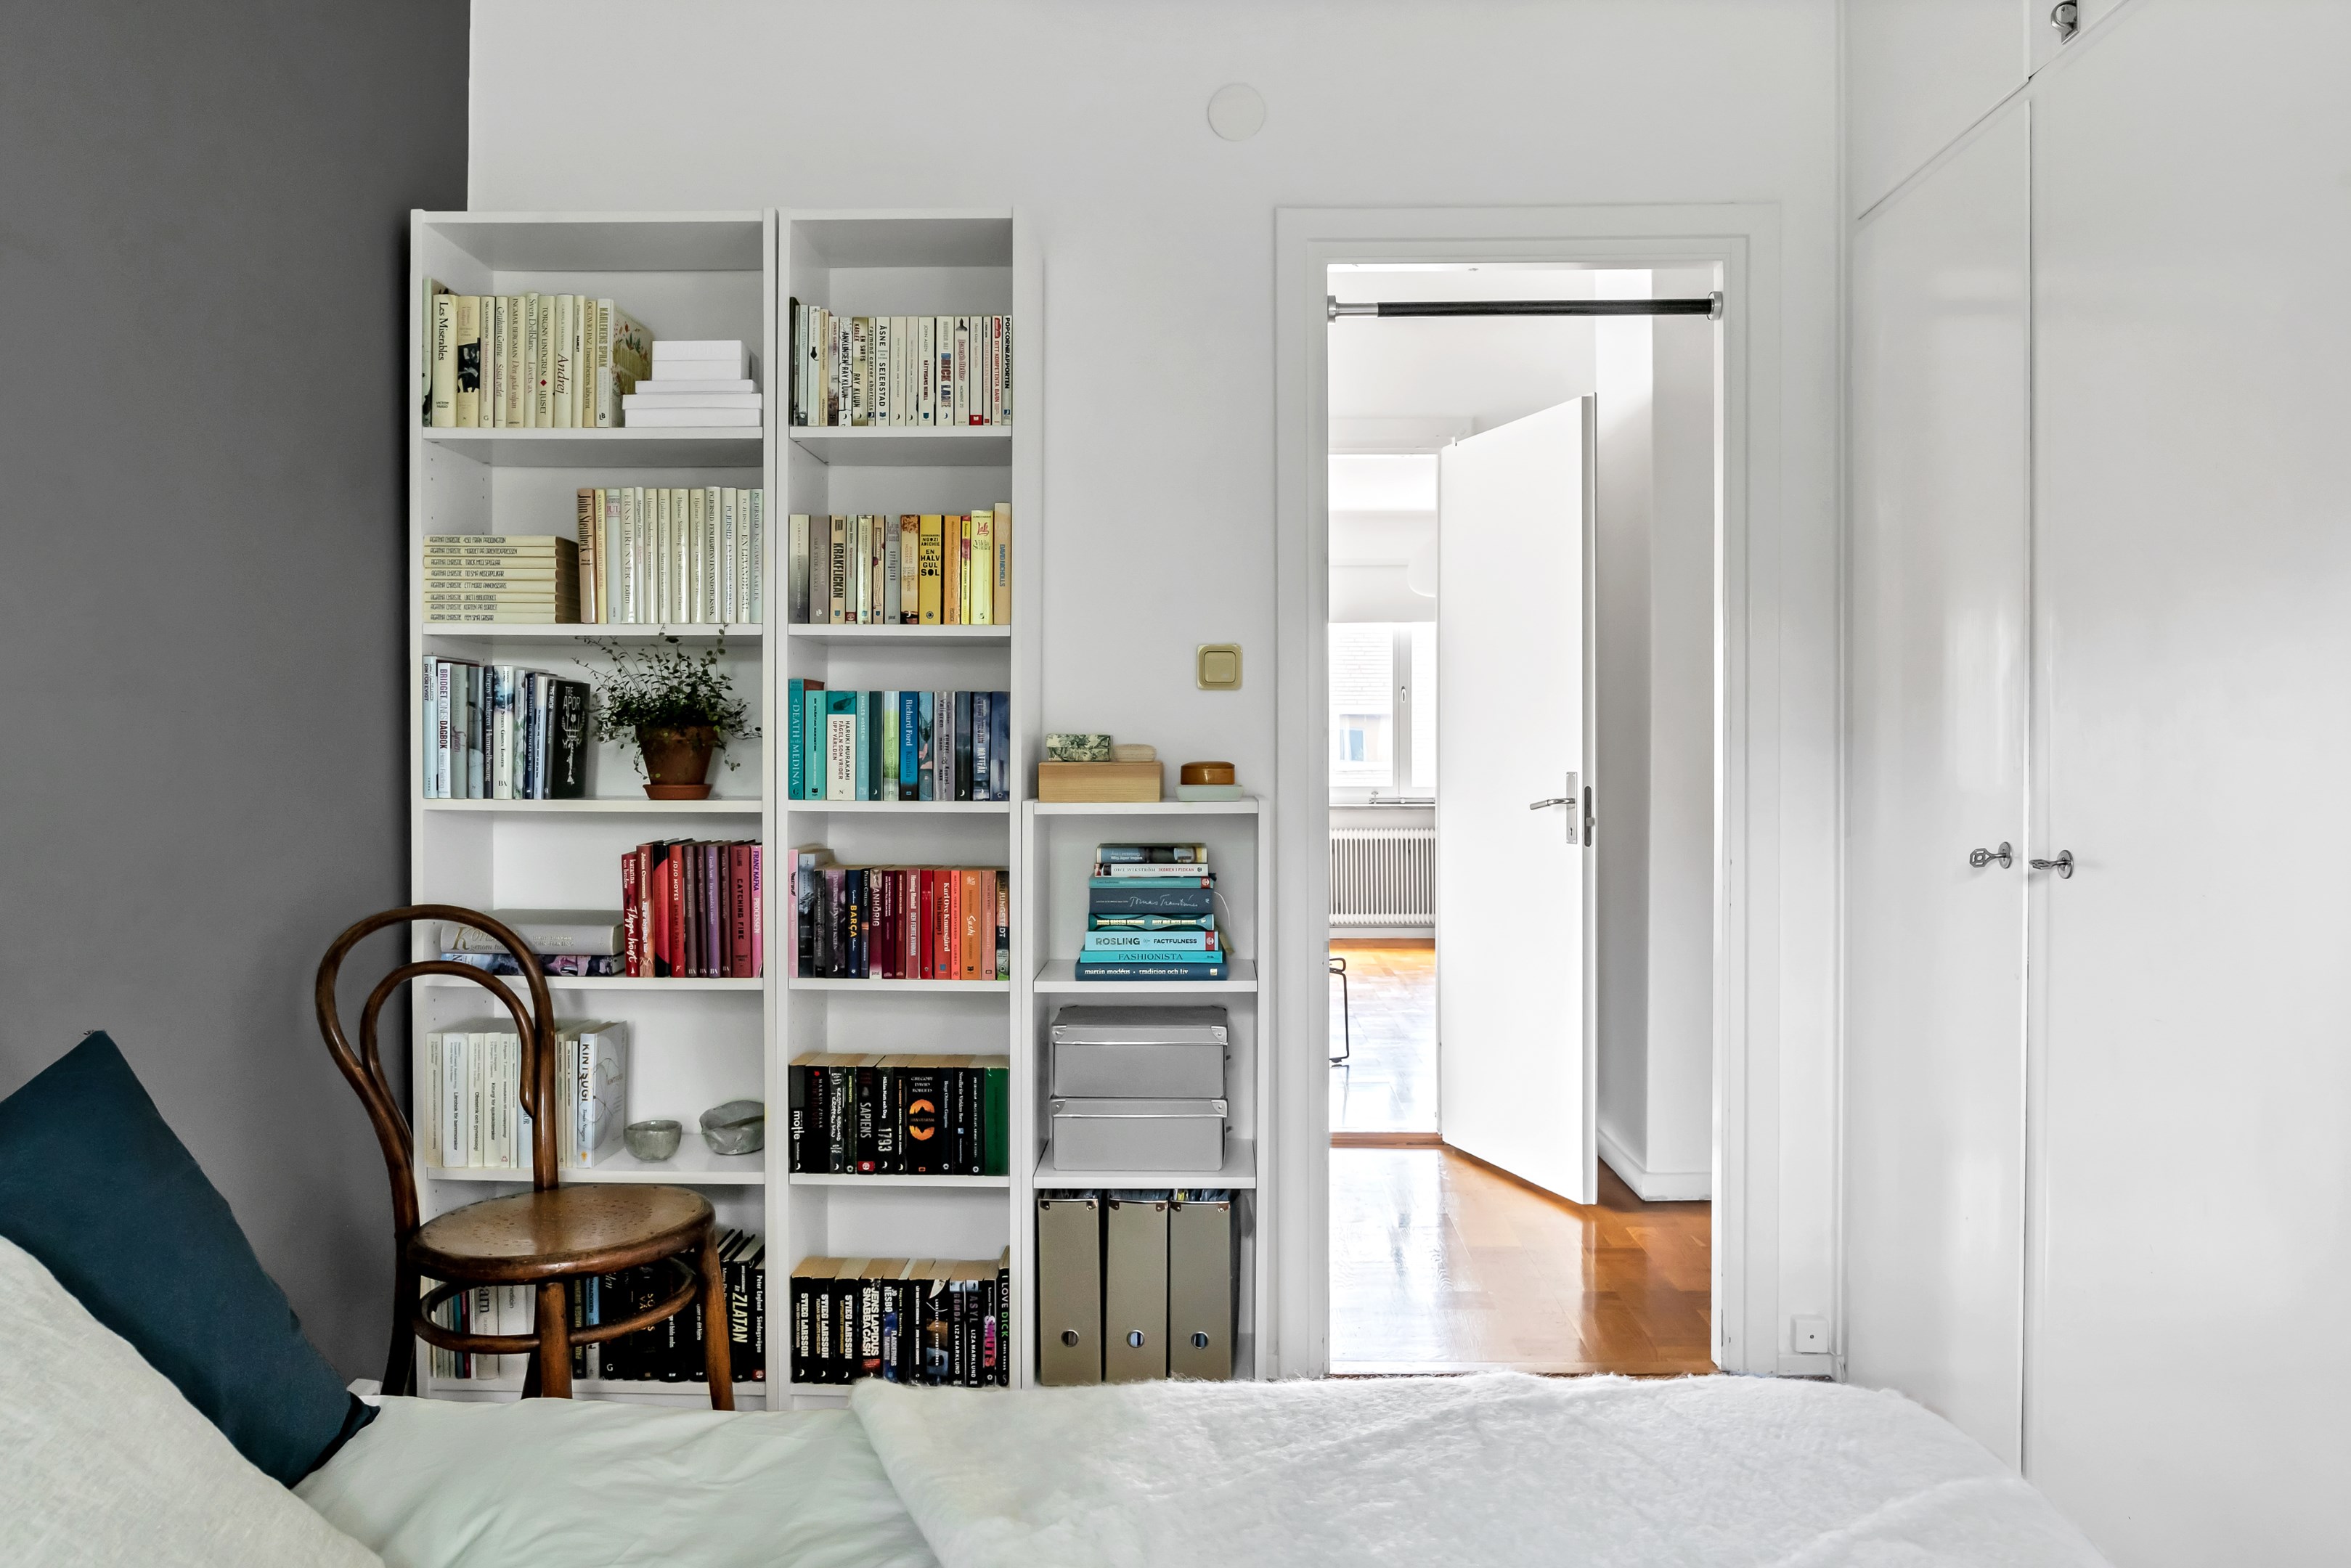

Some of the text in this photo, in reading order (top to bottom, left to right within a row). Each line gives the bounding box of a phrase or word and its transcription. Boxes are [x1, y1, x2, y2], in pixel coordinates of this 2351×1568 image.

[438, 302, 449, 361] Les Misérables
[528, 319, 537, 351] Delblanc
[598, 308, 609, 344] KÄRLEKENS
[879, 326, 888, 347] ÅSNE
[598, 346, 609, 368] SPRÅK
[495, 364, 504, 380] Sista
[510, 375, 519, 391] goda
[555, 354, 570, 395] Andrej
[940, 353, 951, 408] BRICK LANE
[510, 392, 518, 409] viljan
[528, 385, 533, 394] ax
[709, 491, 715, 499] PC
[754, 492, 759, 502] PC
[578, 494, 592, 553] John Steinbeck
[754, 534, 759, 542] EN
[833, 543, 844, 598] KRÅKFLICKAN
[439, 669, 448, 698] BRIDGET
[439, 720, 448, 749] DAGBOK
[452, 726, 467, 753] Synden
[849, 905, 857, 937] BARÇA
[872, 887, 881, 926] ANHÖRIG
[624, 906, 639, 963] Flyga högt
[966, 915, 977, 936] Sushi
[1096, 937, 1140, 946] ROSLING
[581, 1044, 590, 1101] KINTSUGI
[860, 1102, 872, 1138] SAPIENS
[877, 1128, 892, 1152] 1793
[884, 1286, 893, 1312] NESBØ
[969, 1296, 979, 1323] ASYL
[732, 1292, 748, 1343] ZLATAN
[863, 1287, 871, 1356] SNABBA CASH
[871, 1287, 880, 1356] JENS LAPIDUS
[984, 1315, 996, 1367] SMUTS
